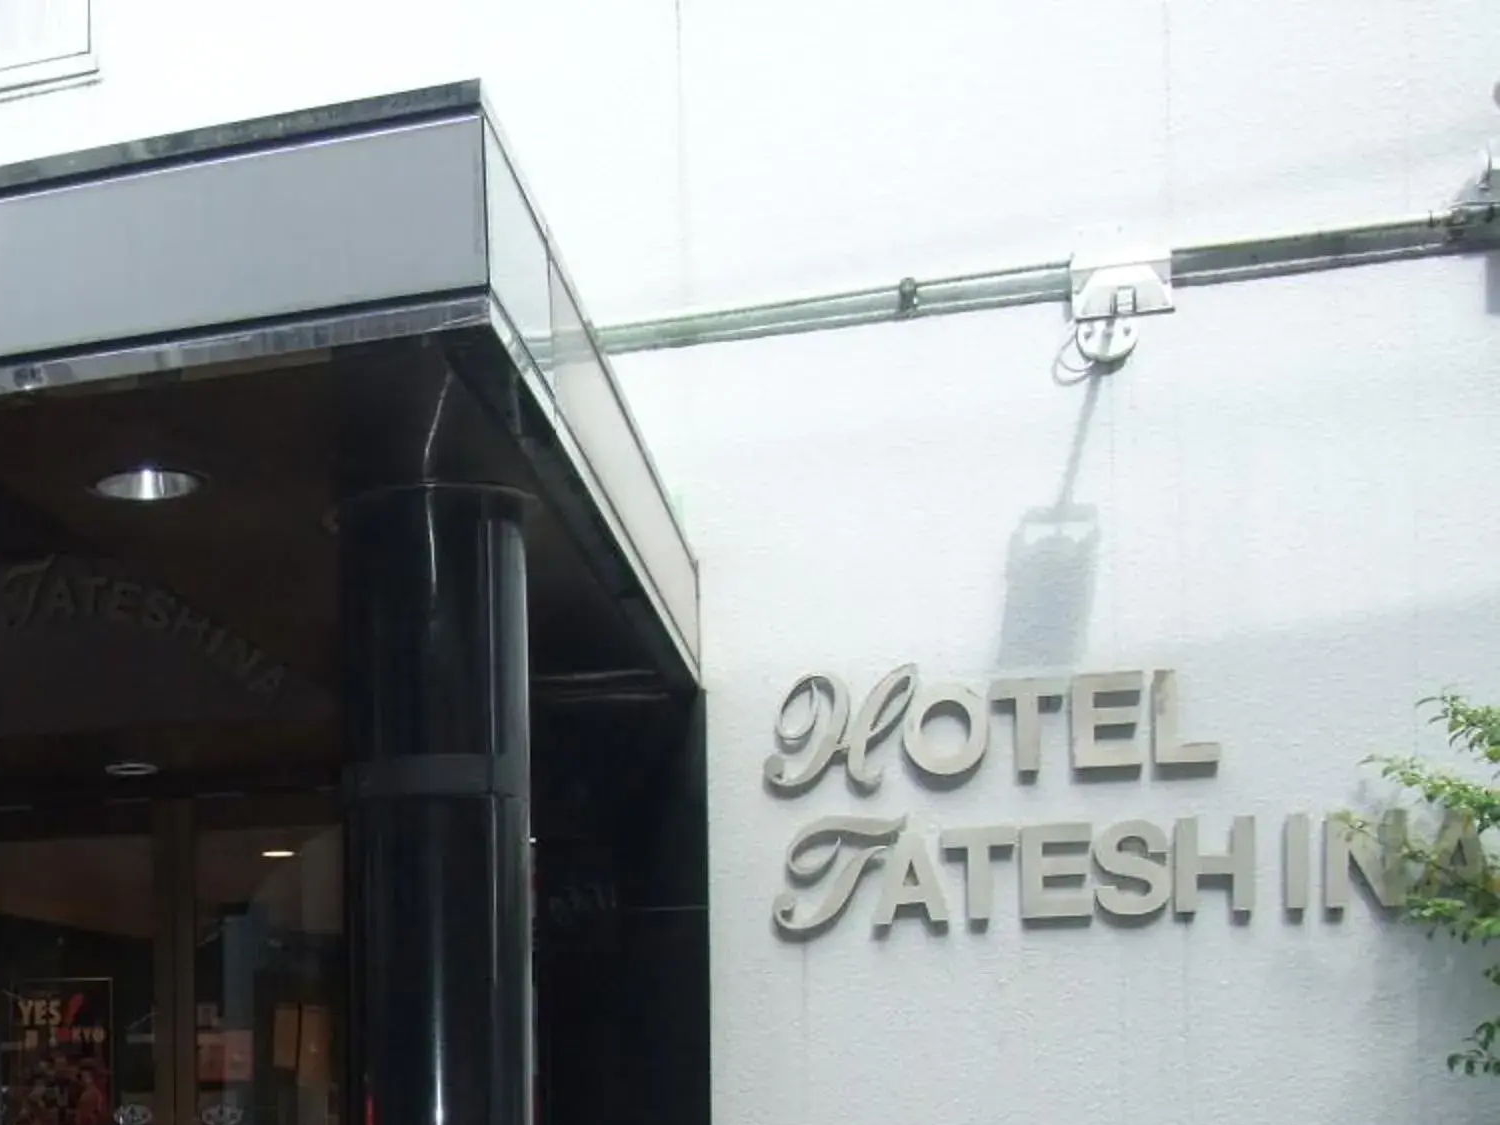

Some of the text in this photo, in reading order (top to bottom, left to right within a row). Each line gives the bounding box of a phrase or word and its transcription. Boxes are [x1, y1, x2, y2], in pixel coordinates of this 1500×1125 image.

[1, 553, 290, 695] TATESHINA
[764, 662, 1221, 796] HOTEL
[771, 808, 1498, 938] TATESHINA
